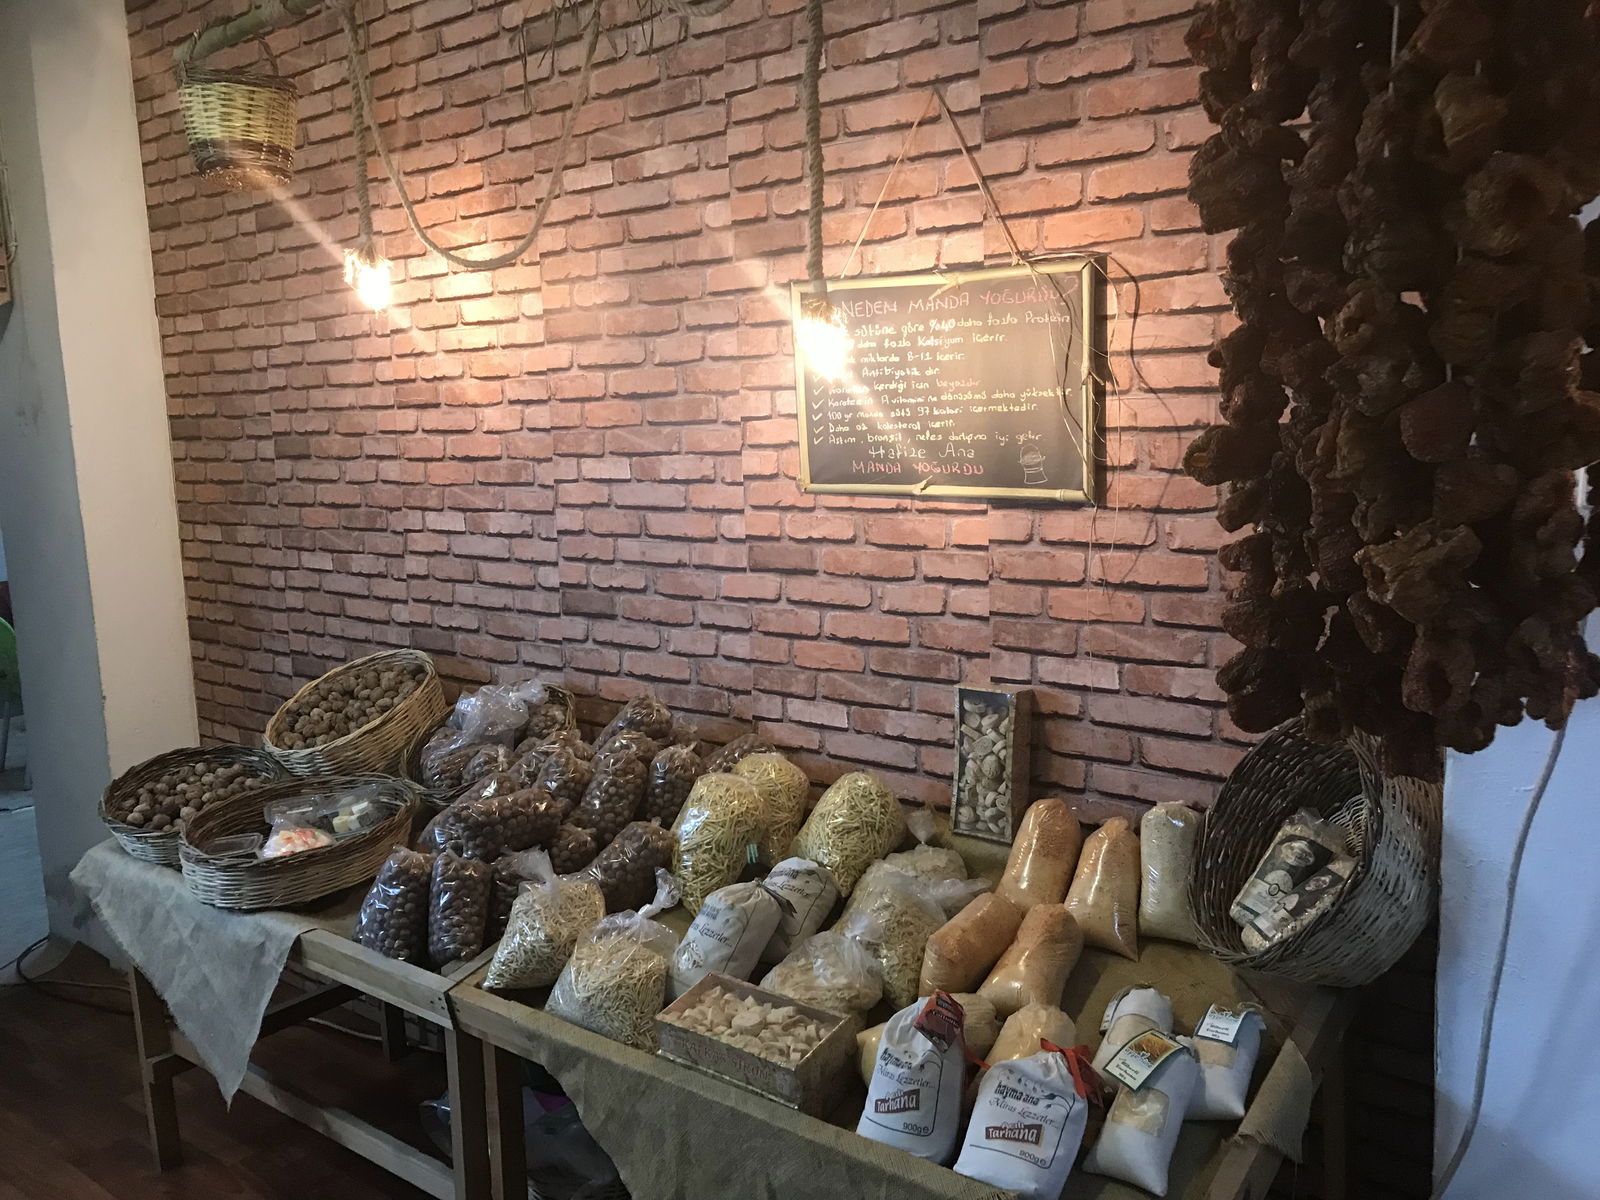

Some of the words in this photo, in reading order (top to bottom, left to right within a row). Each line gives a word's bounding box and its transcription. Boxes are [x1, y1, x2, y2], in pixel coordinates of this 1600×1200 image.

[841, 300, 898, 319] NEDEN
[908, 292, 970, 314] MANDA
[901, 321, 925, 338] göre
[828, 411, 842, 421] 100
[917, 406, 930, 417] 97
[939, 442, 975, 459] Ana
[852, 460, 902, 475] MANDA
[876, 1094, 918, 1113] Tarhana
[988, 1127, 1038, 1144] Tarhana
